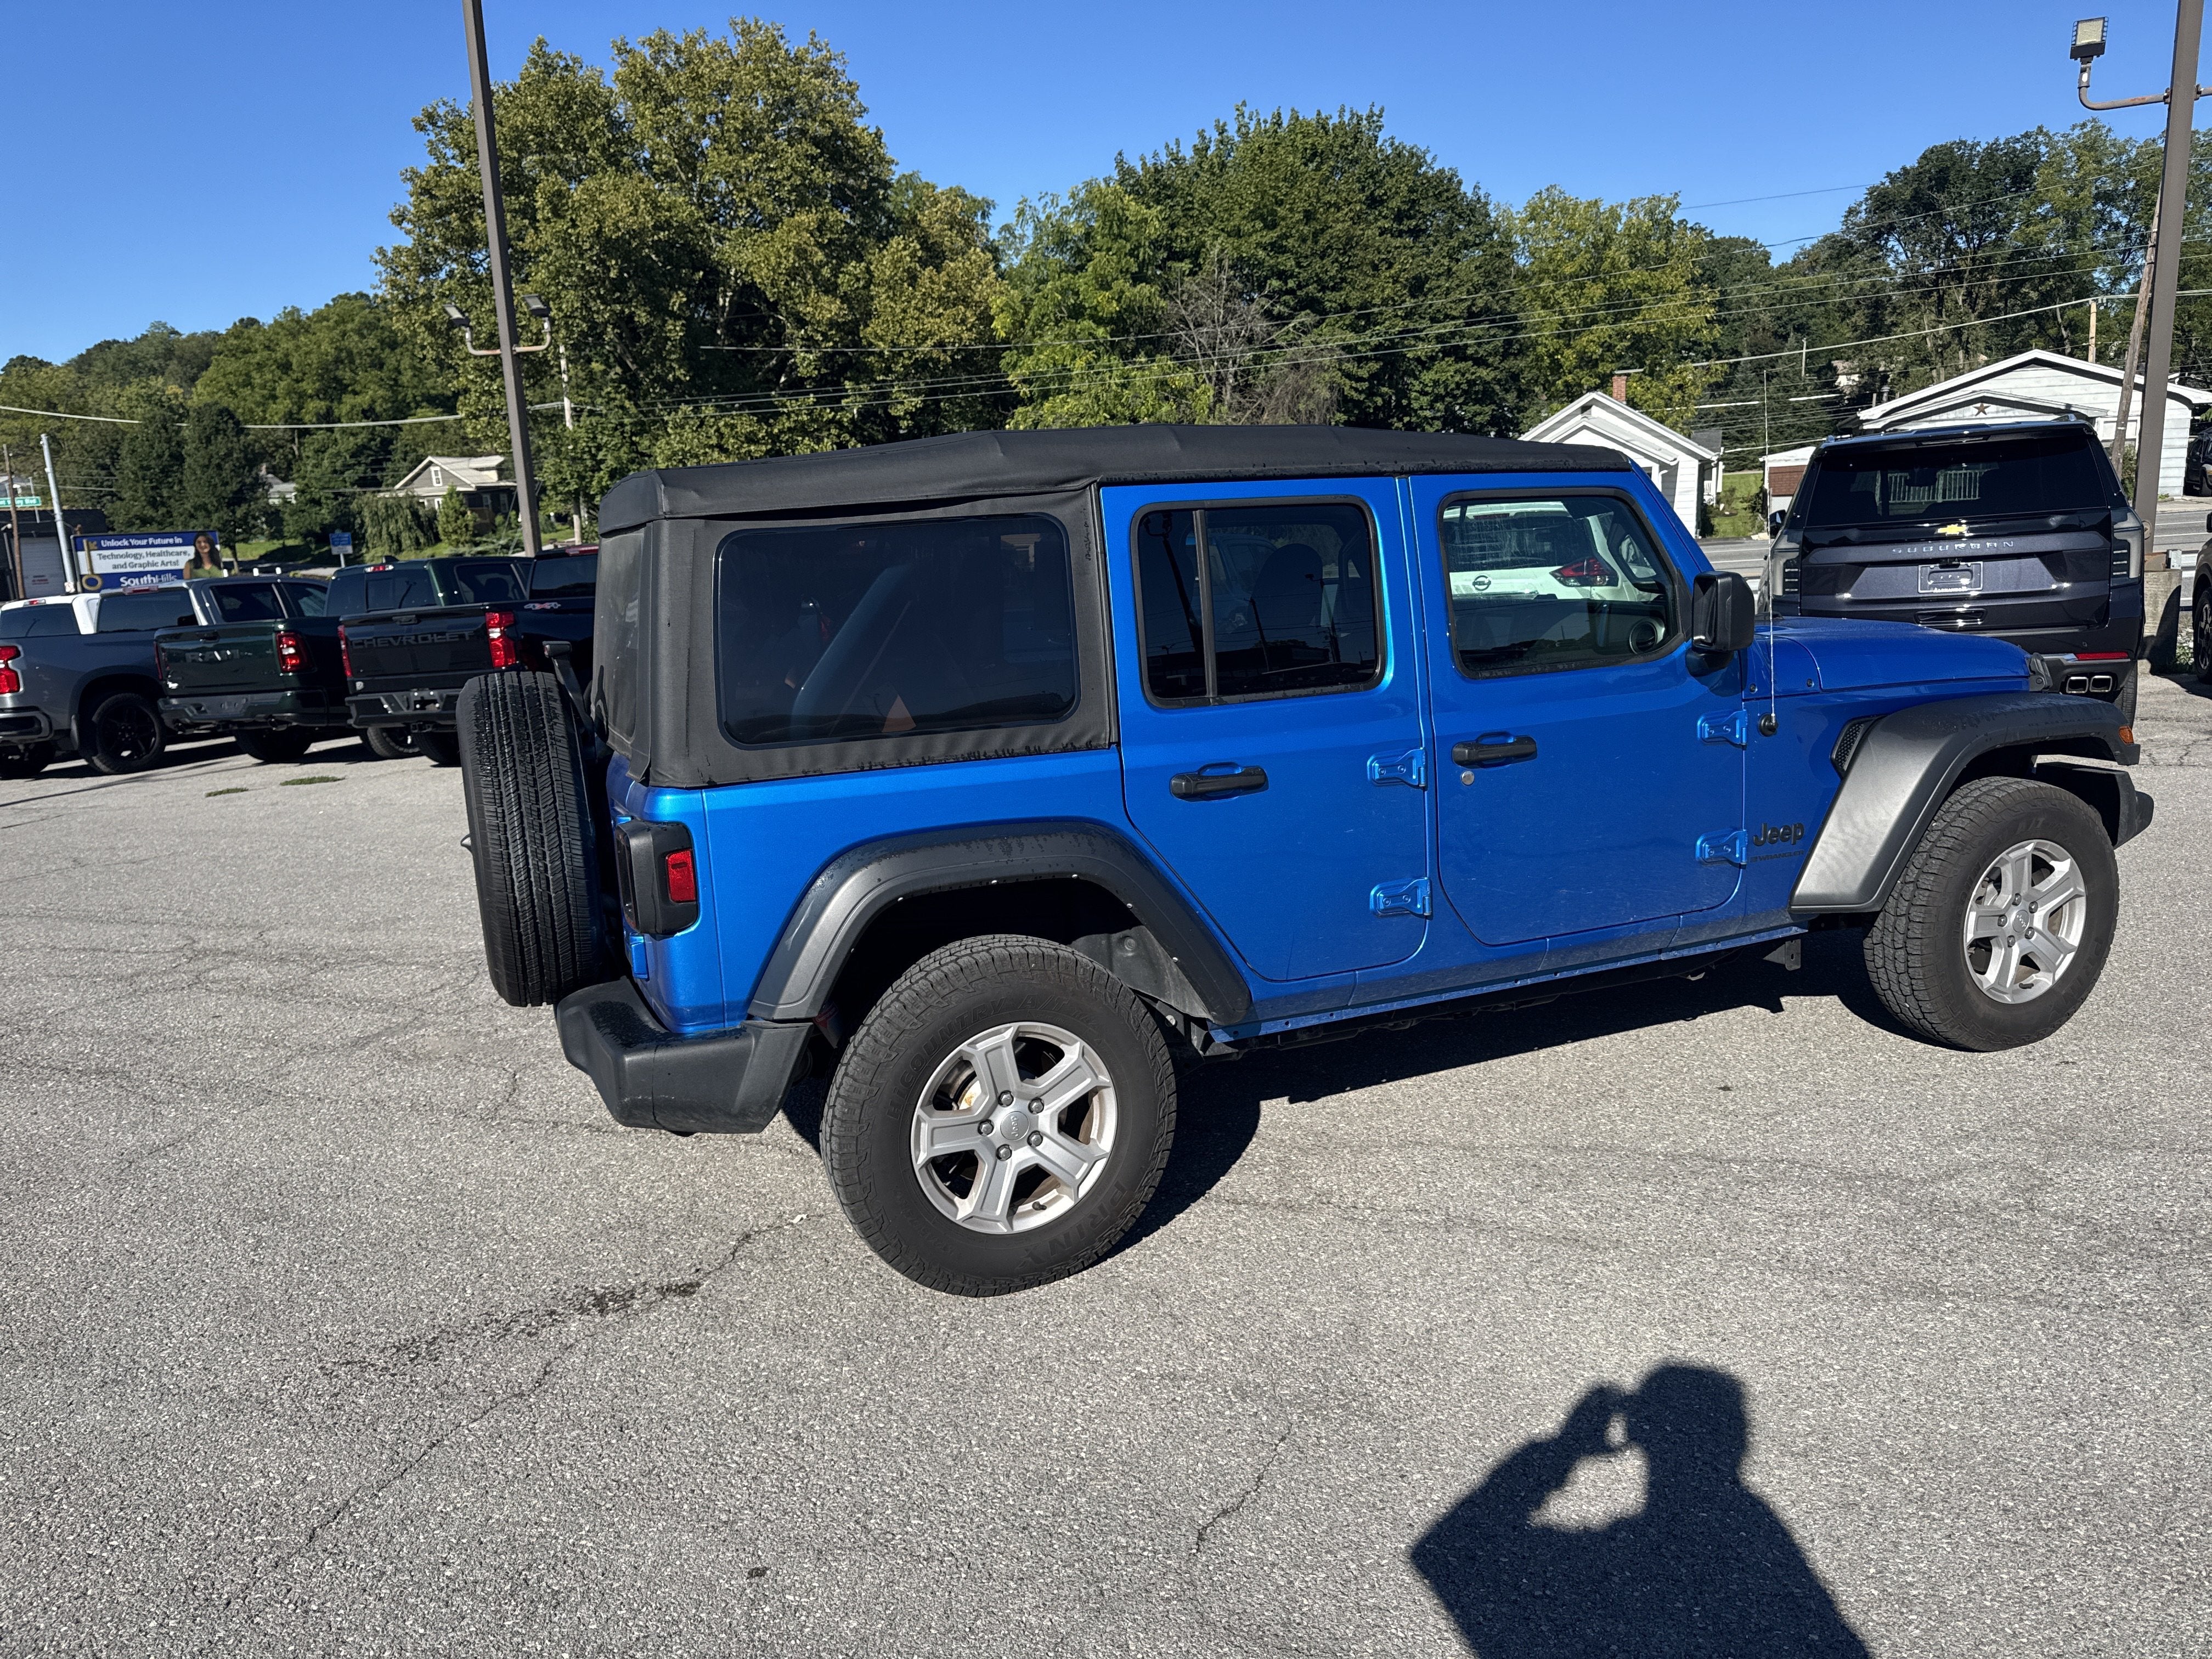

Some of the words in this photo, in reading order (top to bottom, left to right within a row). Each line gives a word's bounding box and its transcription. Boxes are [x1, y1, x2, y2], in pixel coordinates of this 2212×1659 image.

[101, 538, 129, 547] Unlock
[148, 537, 174, 545] Future
[1892, 541, 2013, 554] SUBURBAN
[97, 551, 145, 560] Technology,
[145, 550, 190, 558] Healthcare,
[112, 561, 127, 569] and
[128, 560, 159, 569] Graphic
[352, 631, 474, 649] CHEVROLET
[185, 649, 239, 663] RAM
[1753, 822, 1805, 846] Jeep
[1758, 849, 1804, 861] WRANGLER
[1018, 994, 1070, 1011] A/T
